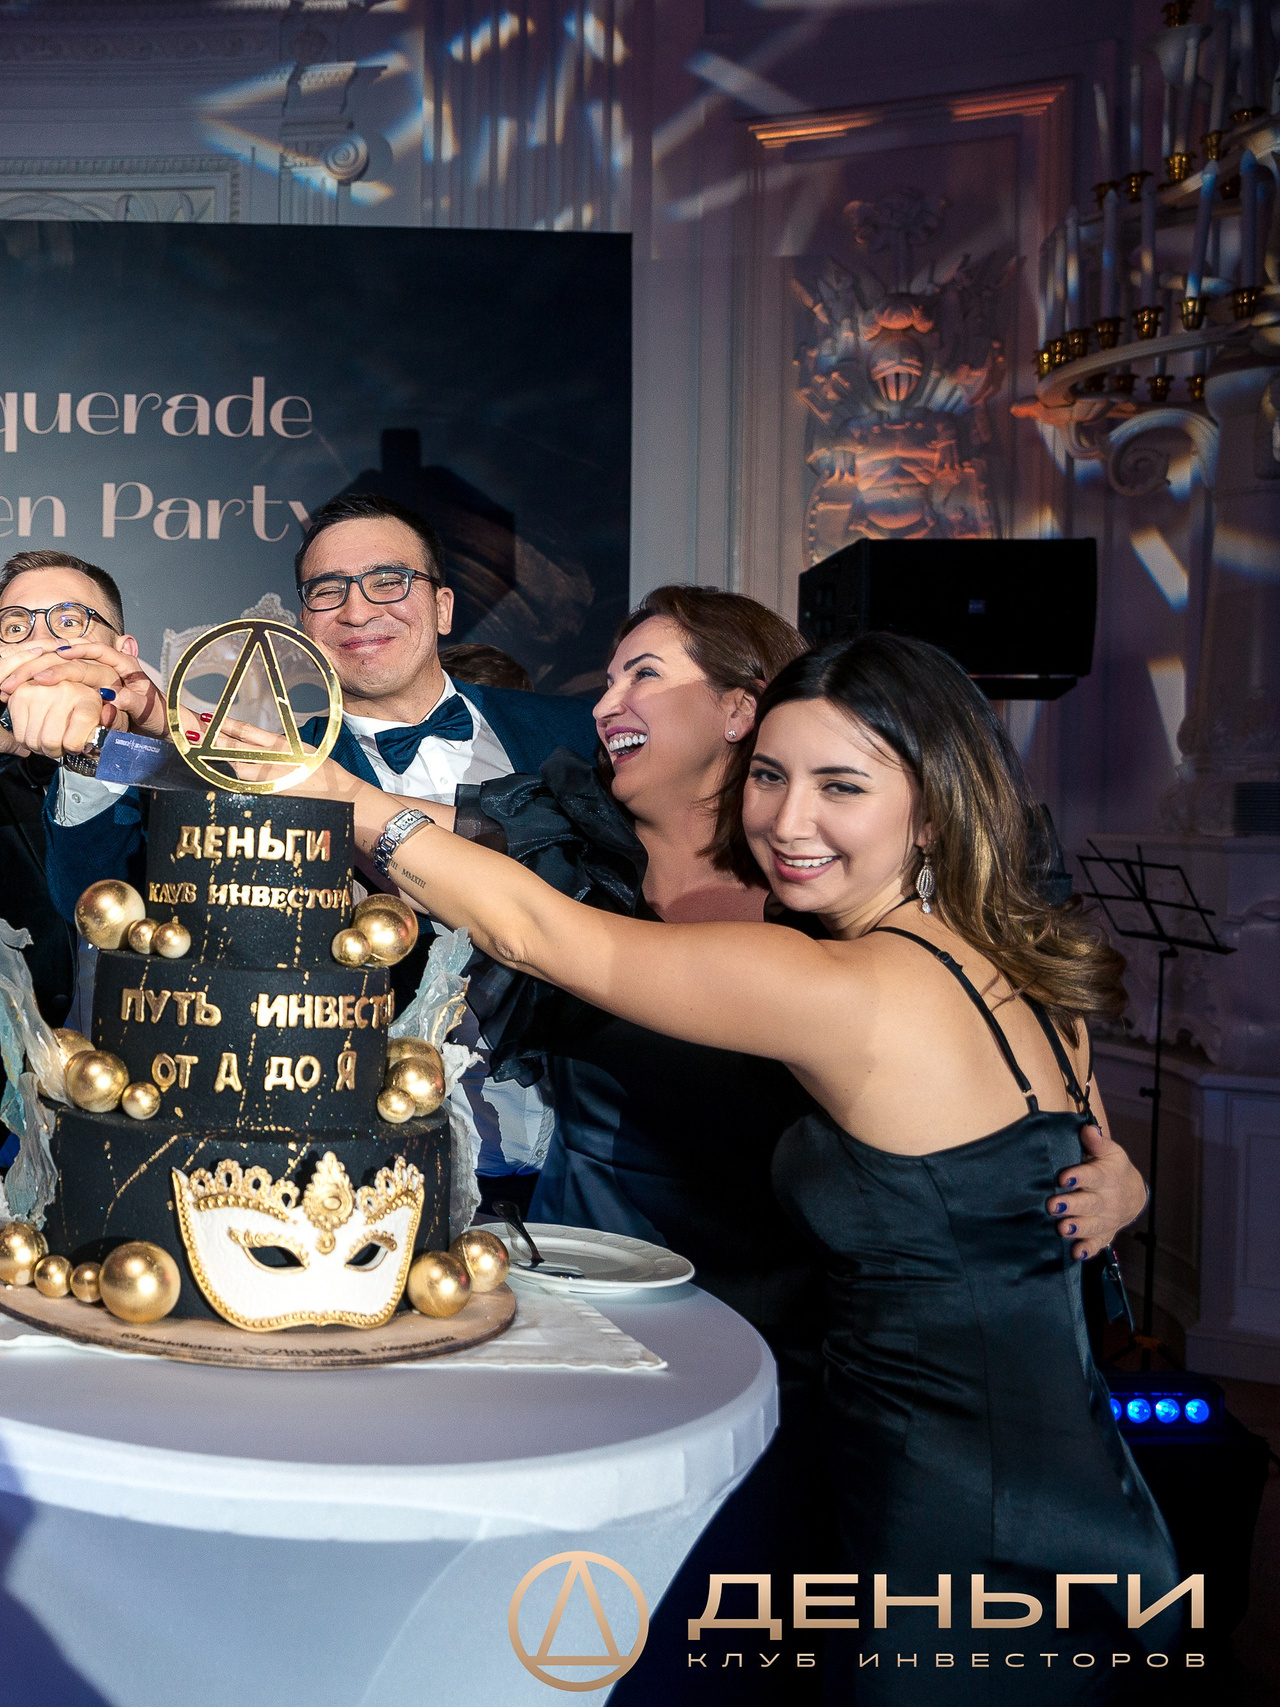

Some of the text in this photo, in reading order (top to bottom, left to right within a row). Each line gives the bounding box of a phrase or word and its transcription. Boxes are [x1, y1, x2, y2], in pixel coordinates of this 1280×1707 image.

[175, 825, 331, 862] ДЕНЬГИ
[148, 881, 198, 906] КЛУБ
[120, 988, 222, 1027] ПУТЬ
[152, 1051, 357, 1093] ОТ А ДО Я
